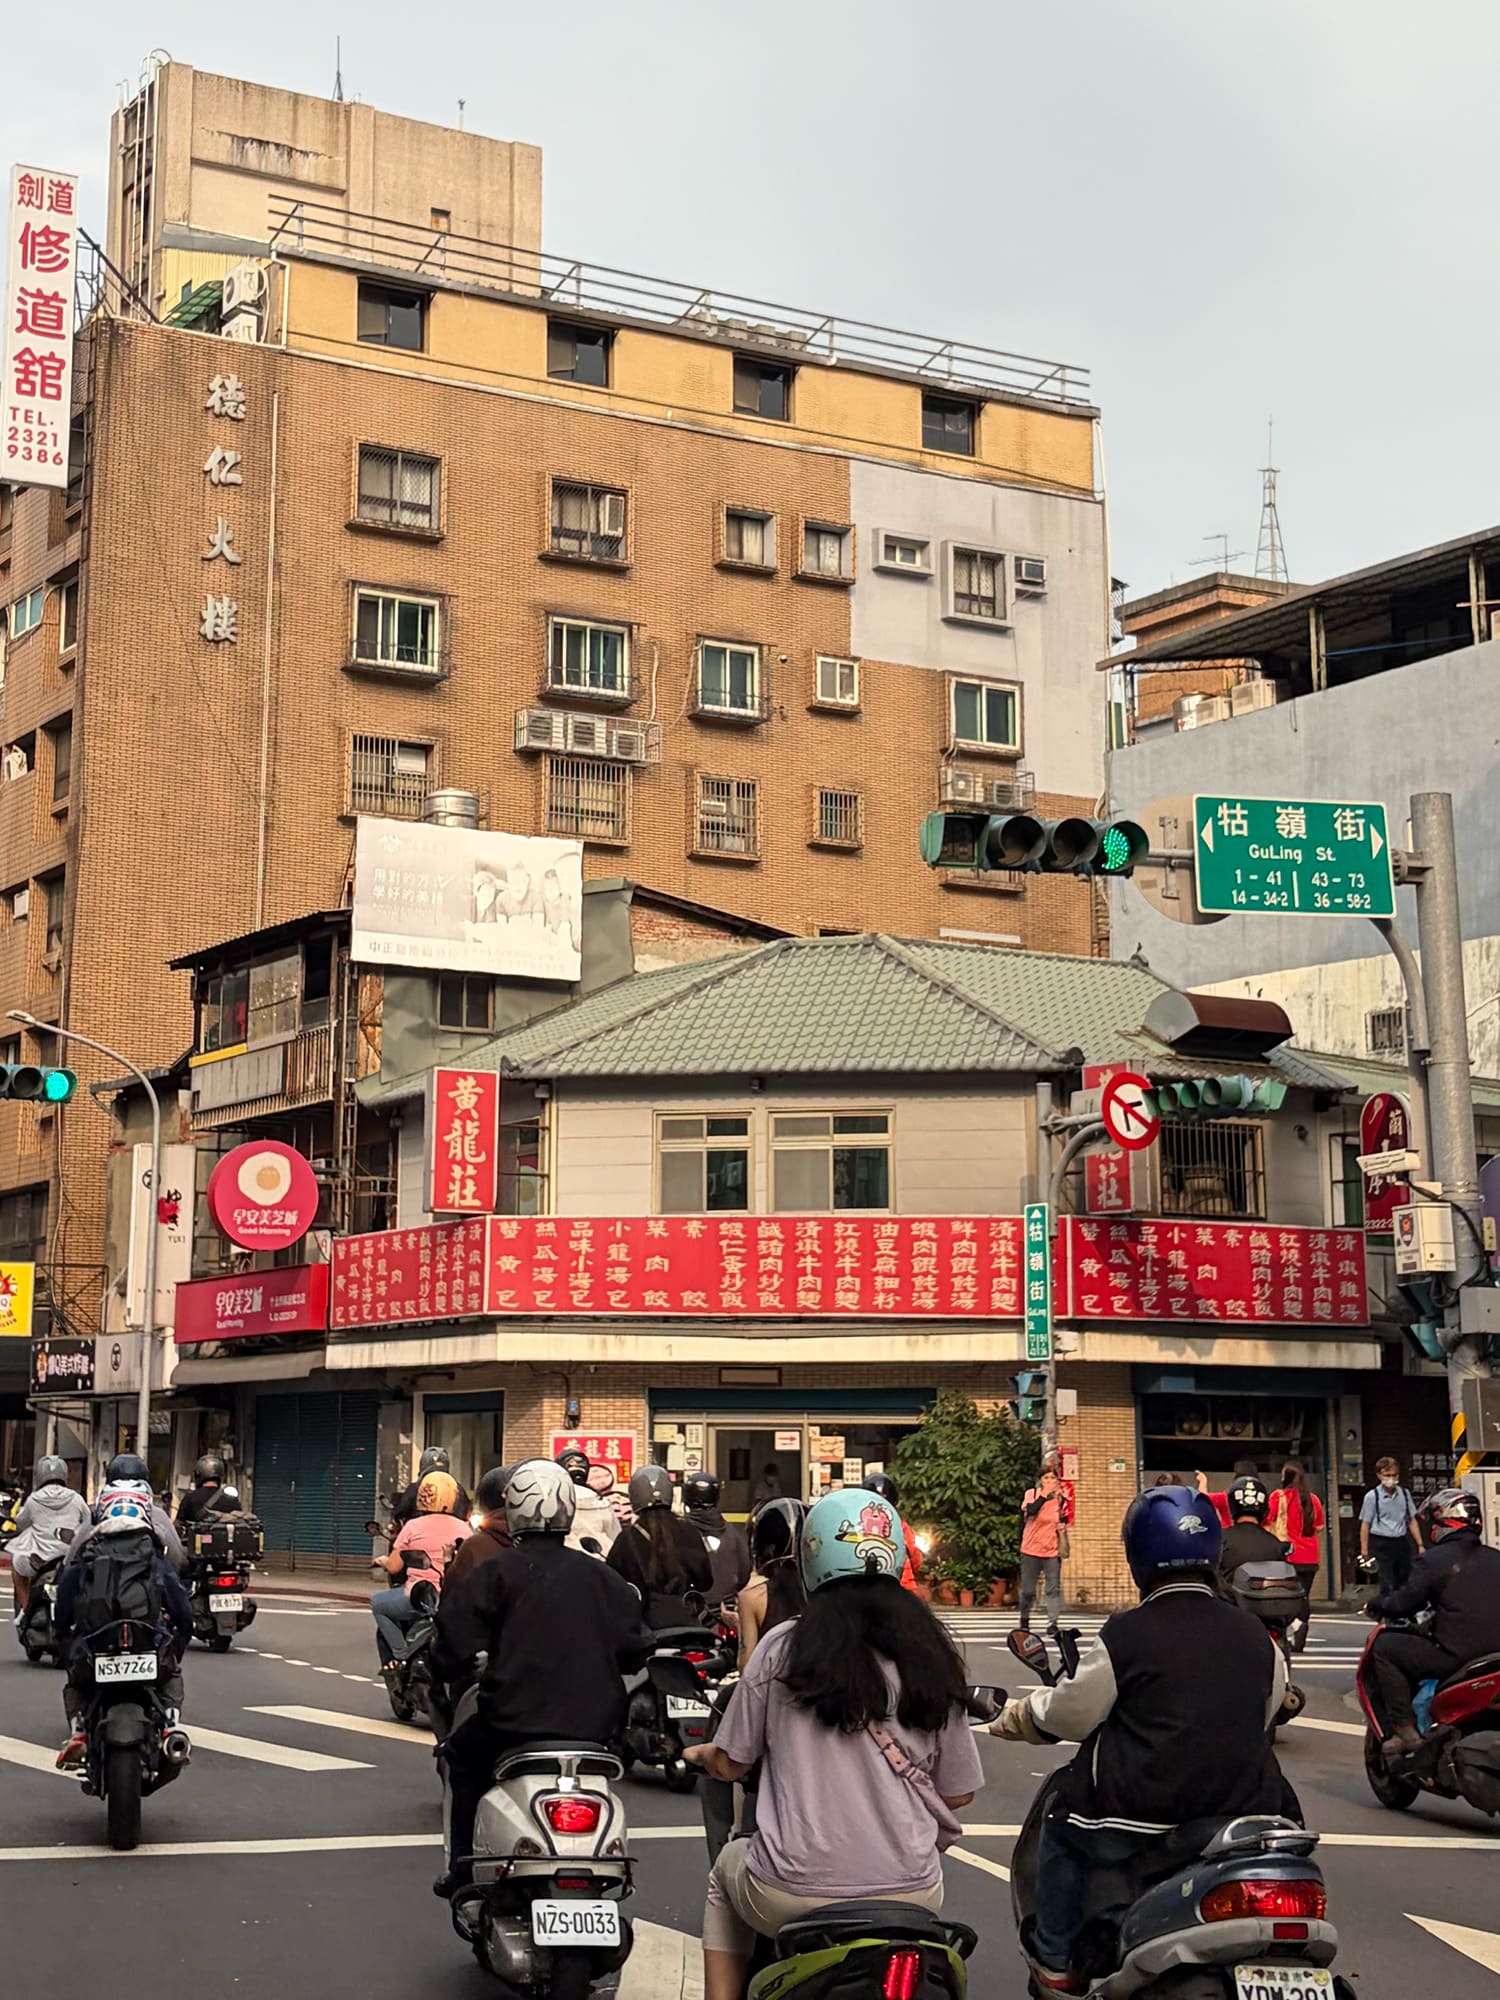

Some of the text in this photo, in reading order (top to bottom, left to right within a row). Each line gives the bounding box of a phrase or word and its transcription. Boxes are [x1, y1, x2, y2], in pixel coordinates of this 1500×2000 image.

[17, 173, 74, 216] 劍道
[8, 427, 58, 447] 2321
[9, 406, 54, 427] TEL.
[7, 445, 63, 466] 9386
[1217, 802, 1366, 842] 牯嶺街
[1249, 844, 1336, 864] GuLing St.
[443, 1075, 487, 1208] 黃龍莊
[233, 1208, 298, 1226] 早安美芝城
[569, 1221, 595, 1308] 品味小湯包
[605, 1220, 632, 1308] 小籠湯包
[642, 1220, 670, 1308] 菜肉餃
[680, 1220, 709, 1308] 素餃
[834, 1221, 861, 1310] 紅燒牛肉麵
[871, 1221, 901, 1309] 油豆腐細粉
[1029, 1222, 1045, 1301] 牯嶺街
[98, 1660, 154, 1676] NSX-7266
[536, 1911, 616, 1934] NZS-0033
